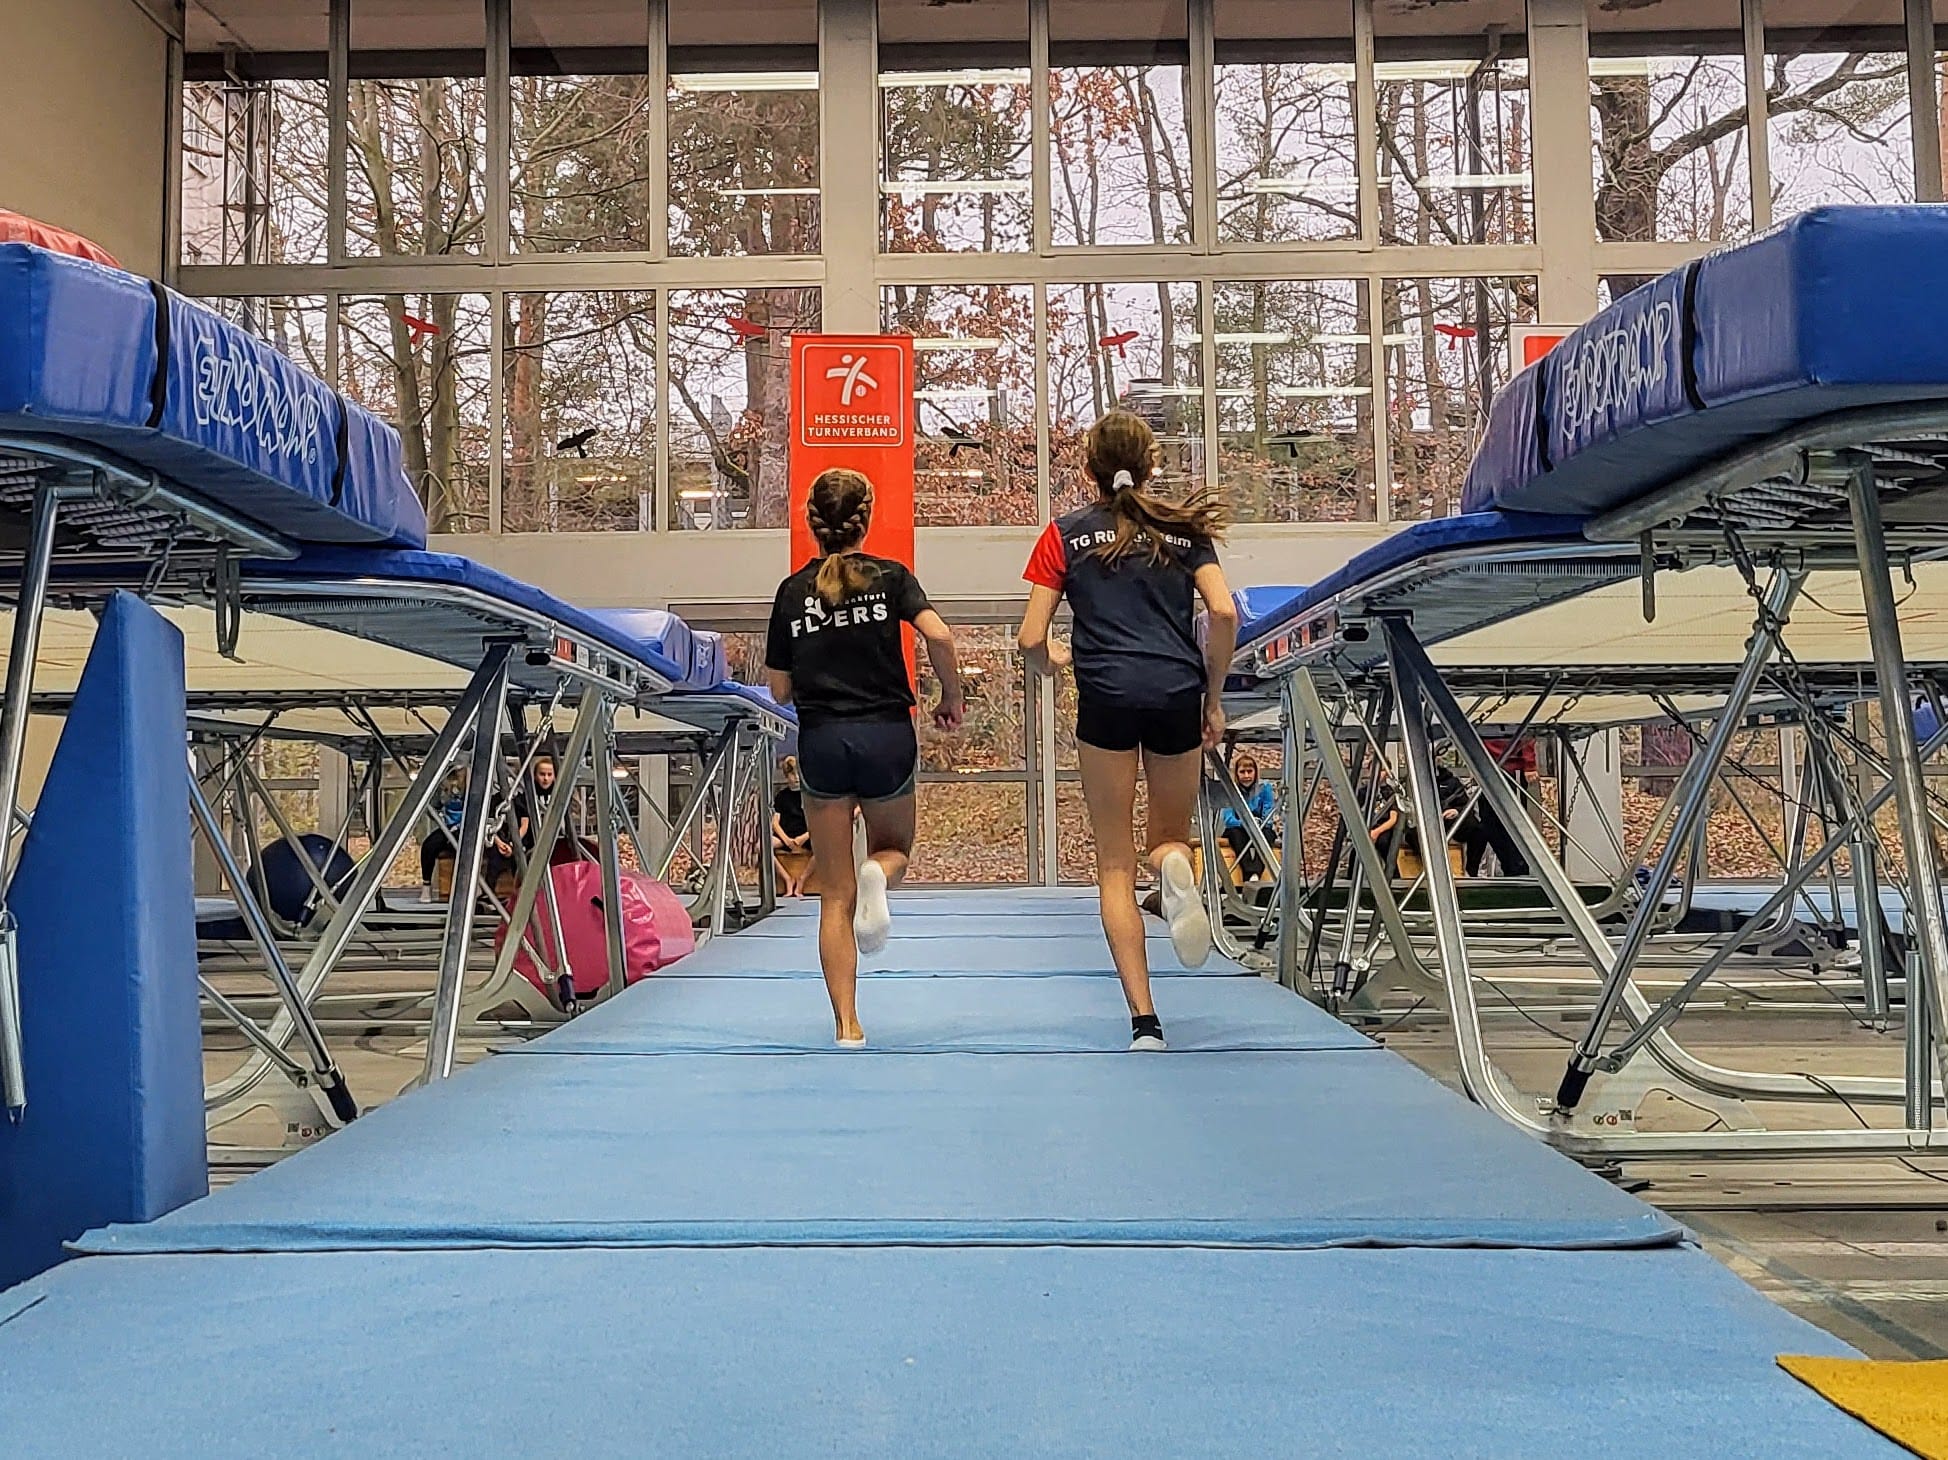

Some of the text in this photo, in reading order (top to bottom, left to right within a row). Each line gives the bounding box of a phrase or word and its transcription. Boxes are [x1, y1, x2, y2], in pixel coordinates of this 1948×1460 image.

[814, 414, 891, 425] HESSISCHER
[808, 427, 898, 437] TURNVERBAND
[1069, 534, 1091, 551] TG
